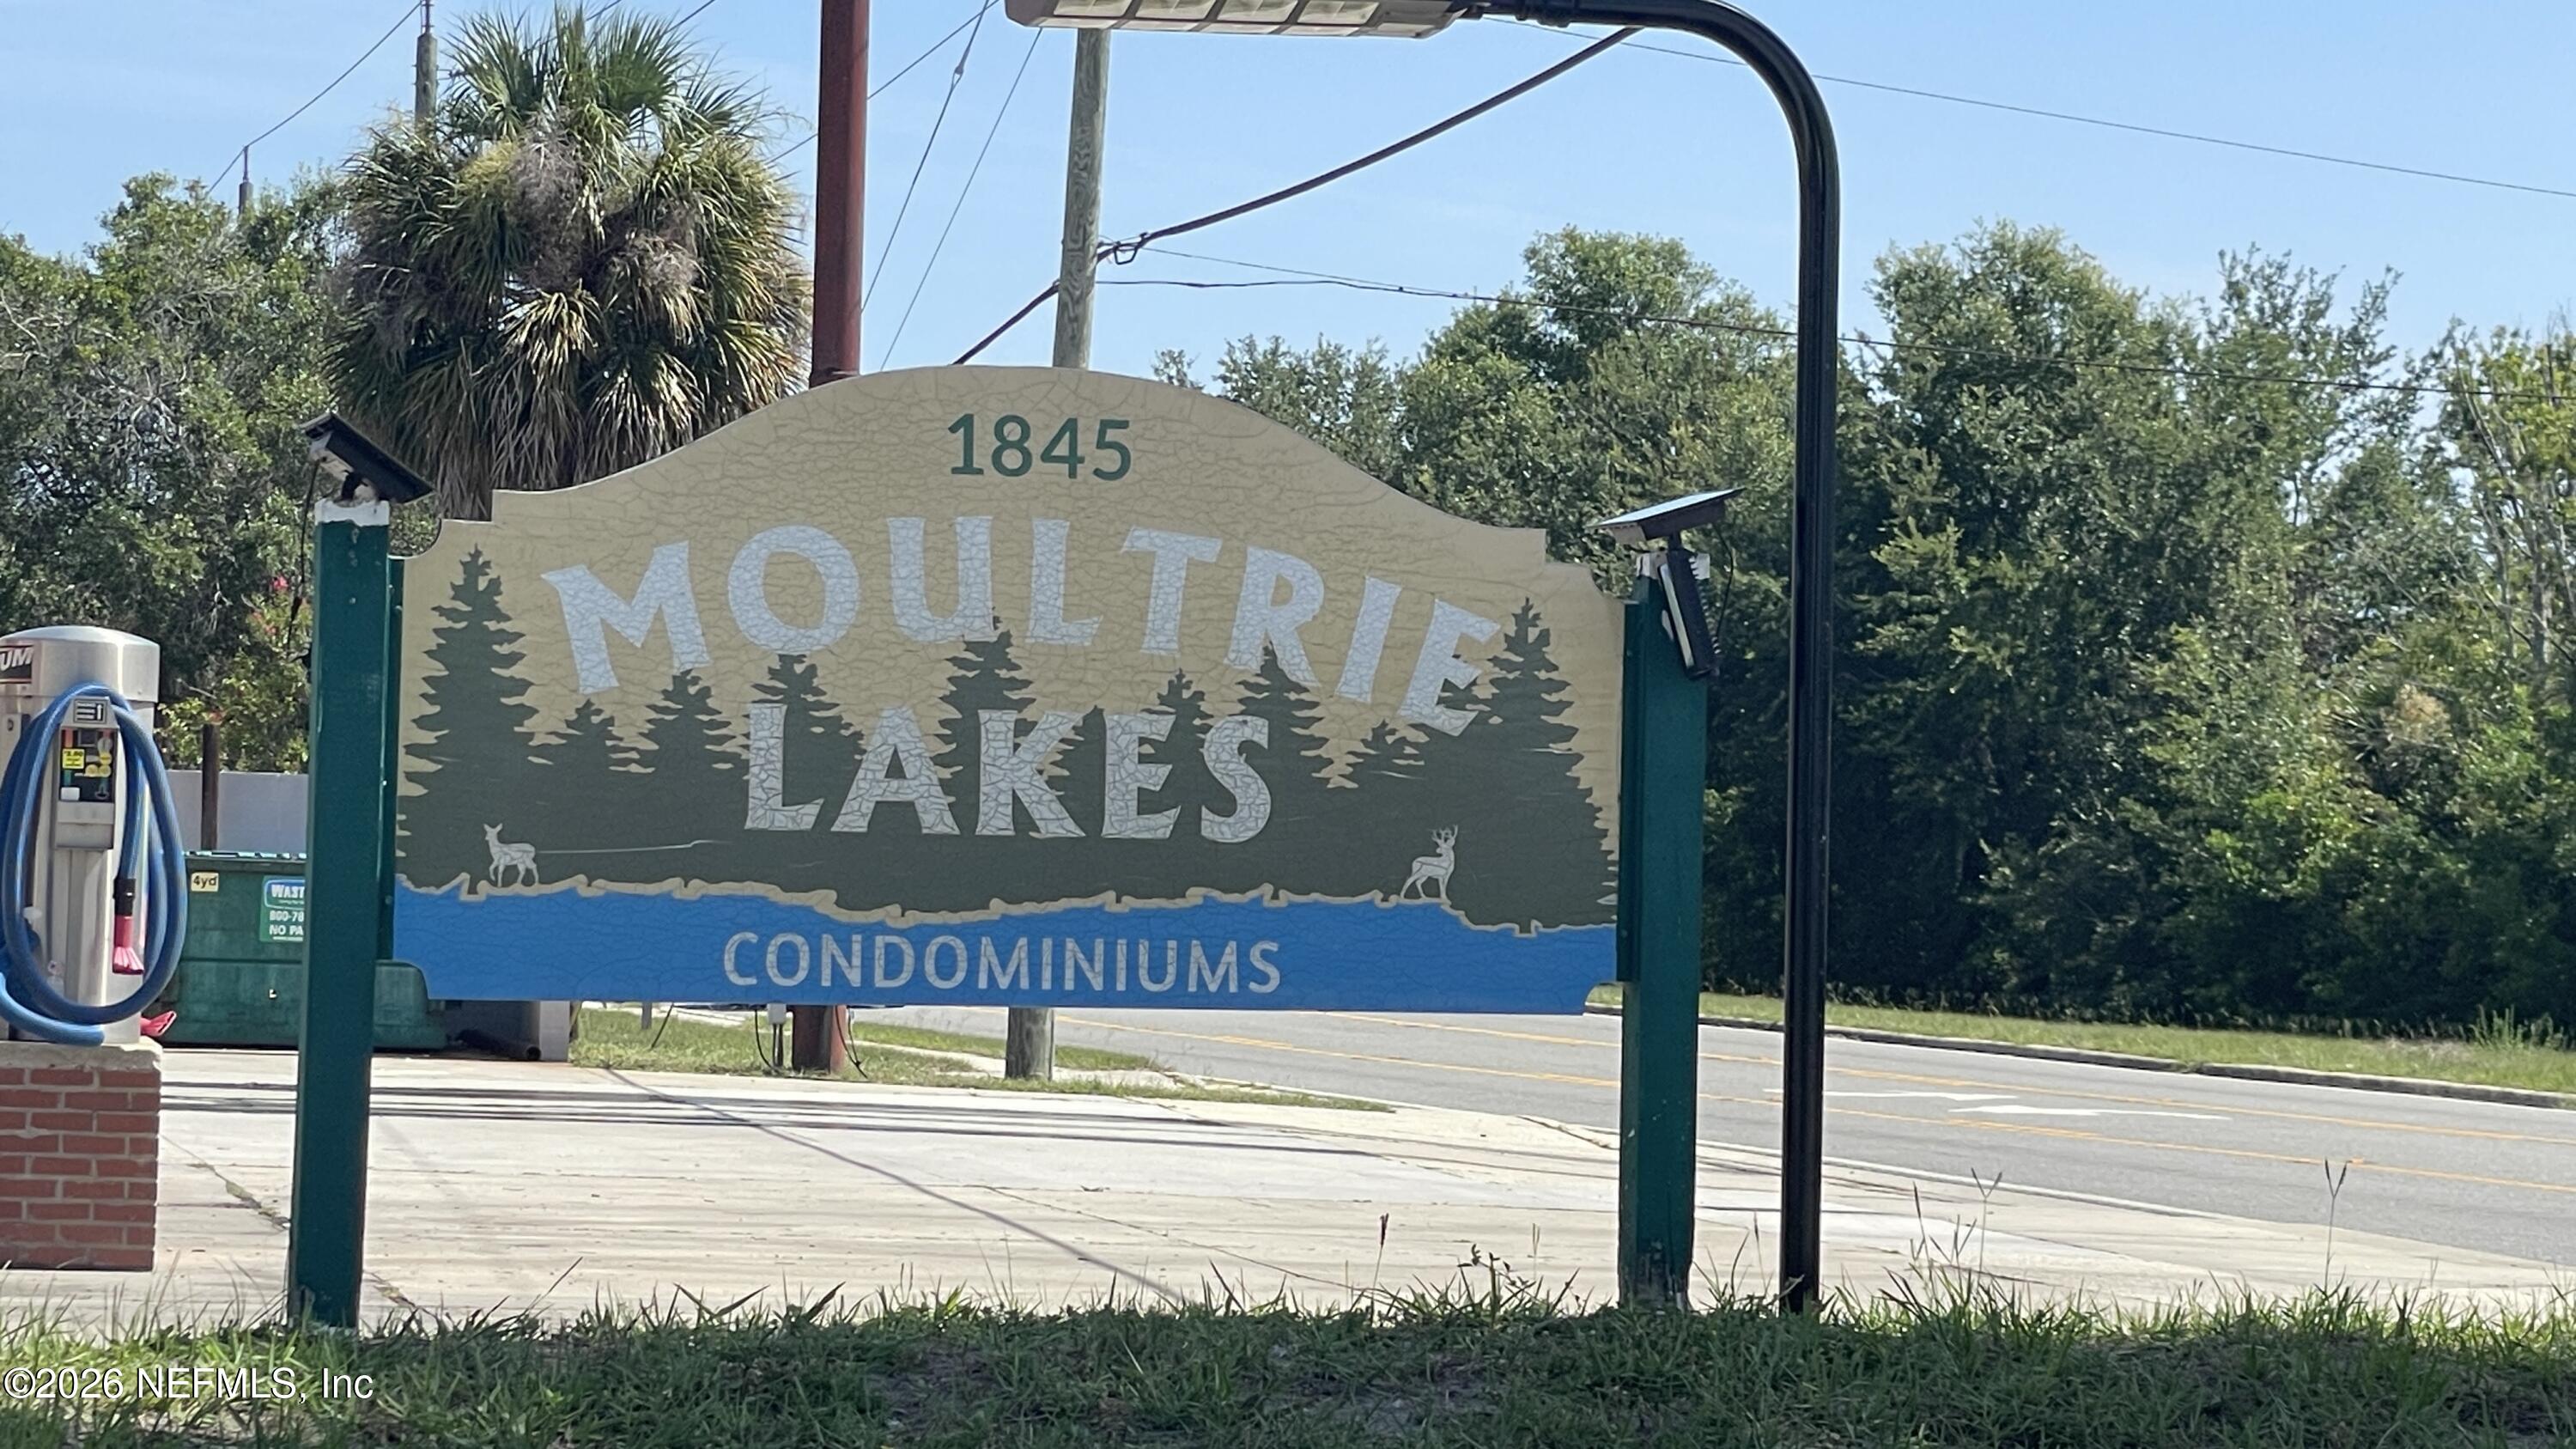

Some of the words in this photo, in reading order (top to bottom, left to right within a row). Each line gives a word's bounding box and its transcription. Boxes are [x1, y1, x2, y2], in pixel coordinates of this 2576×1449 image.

[950, 414, 1133, 481] 1845
[541, 515, 1500, 737] MOULTRIE
[744, 702, 1272, 843] LAKES
[193, 875, 217, 889] 4yd
[269, 924, 286, 935] NO
[723, 932, 1282, 994] CONDOMINIUMS
